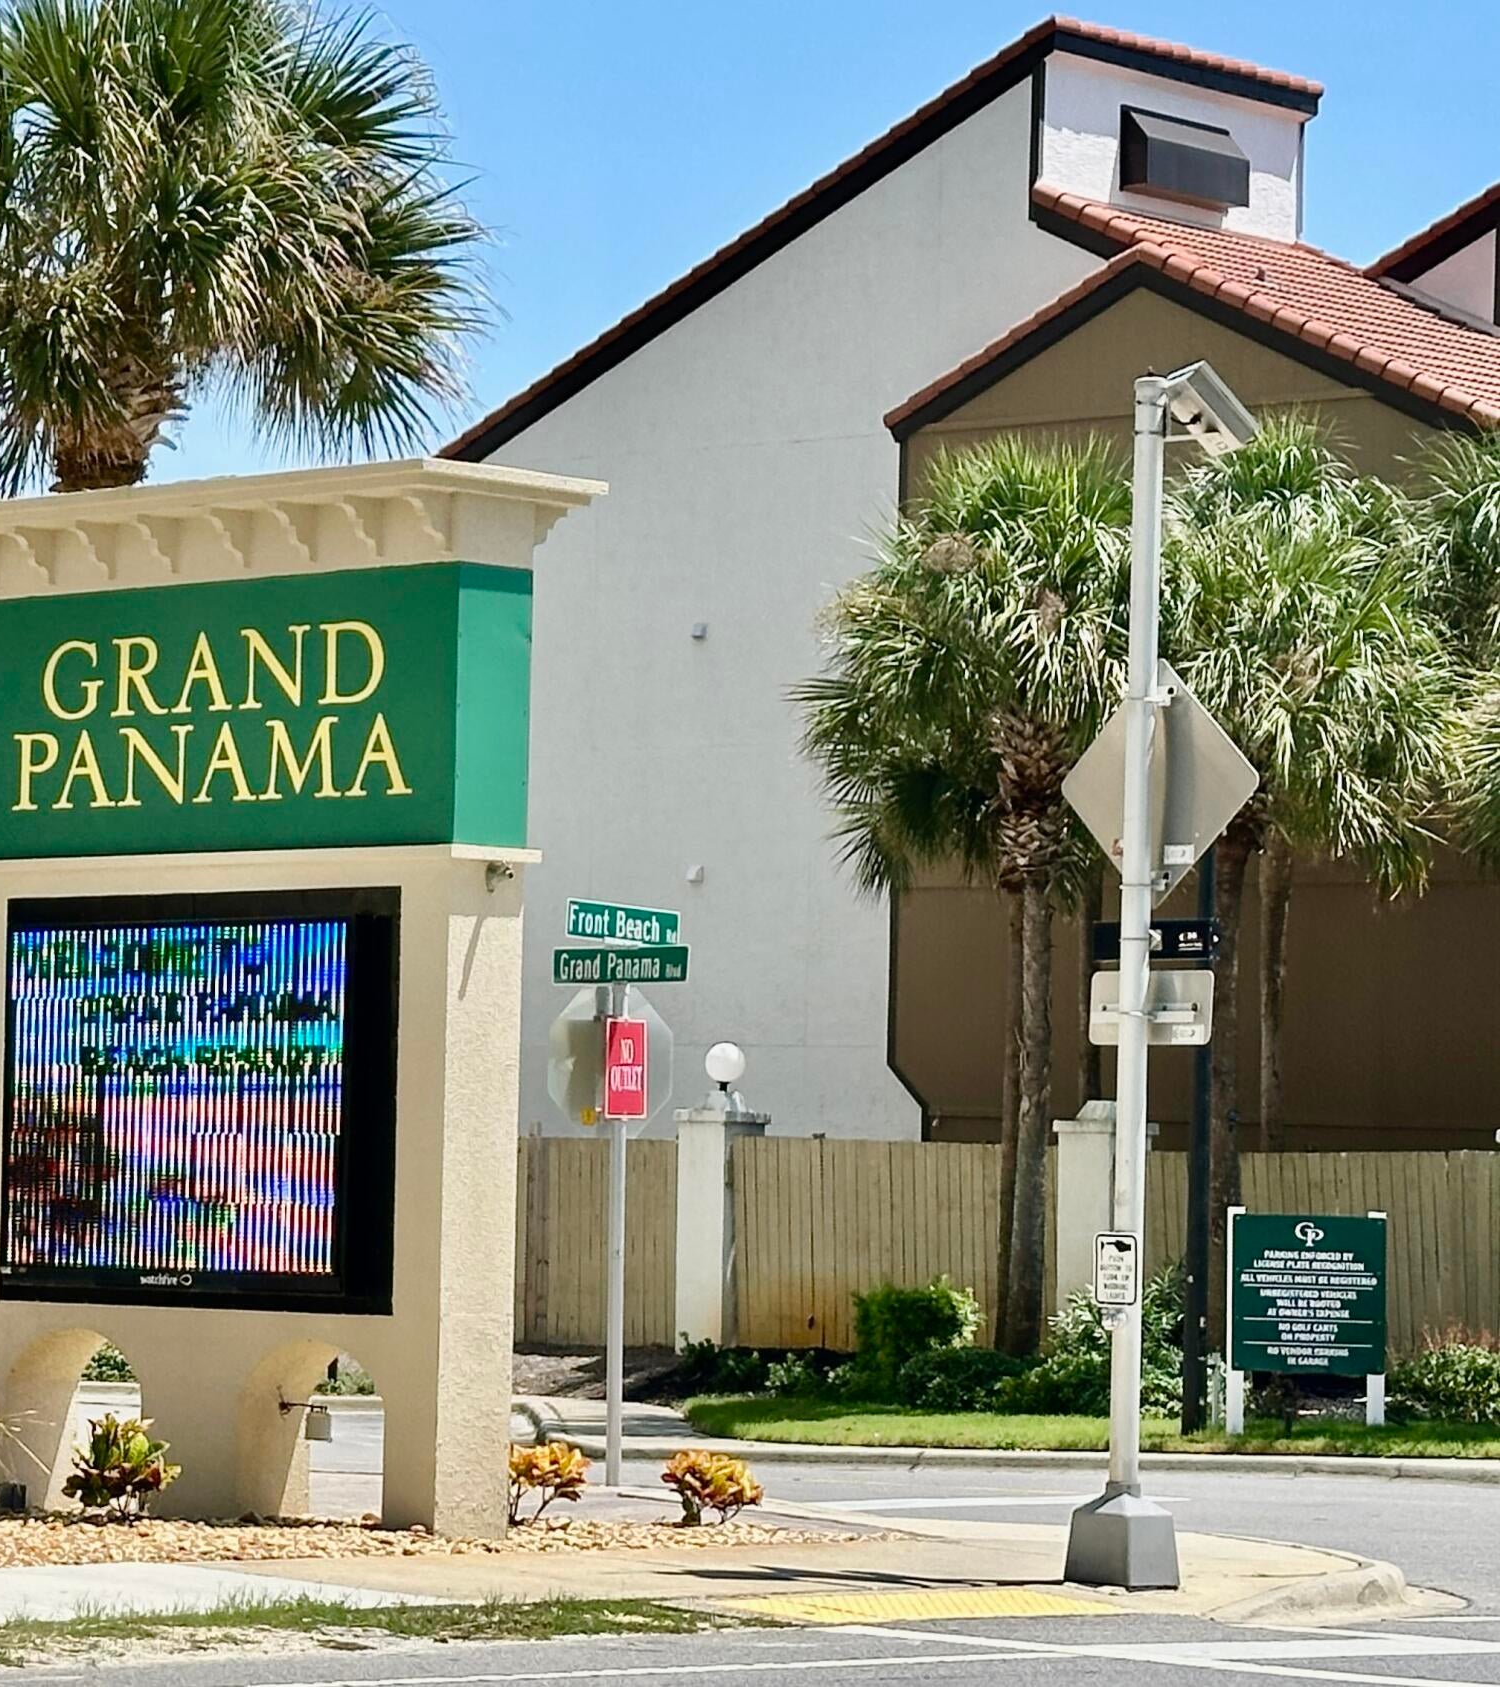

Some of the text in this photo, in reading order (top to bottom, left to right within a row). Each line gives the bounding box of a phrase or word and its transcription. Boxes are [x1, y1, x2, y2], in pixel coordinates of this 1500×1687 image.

[42, 619, 386, 721] GRAND
[11, 711, 413, 811] PANAMA
[568, 903, 678, 944] Front Beach Rd
[559, 953, 600, 980] Grand
[607, 953, 660, 979] Panama
[620, 1038, 634, 1065] NO
[610, 1065, 643, 1091] OUTLET
[1343, 1252, 1354, 1261] BY
[1240, 1273, 1378, 1286] ALL VEHICLES MUST BE REGISTERED
[1276, 1299, 1295, 1307] WILL
[1297, 1299, 1308, 1308] BE
[1266, 1308, 1277, 1316] AT
[1278, 1323, 1338, 1333] NO GOLF CARTS
[1280, 1332, 1336, 1342] ON PROPERTY
[1267, 1346, 1279, 1355] NO
